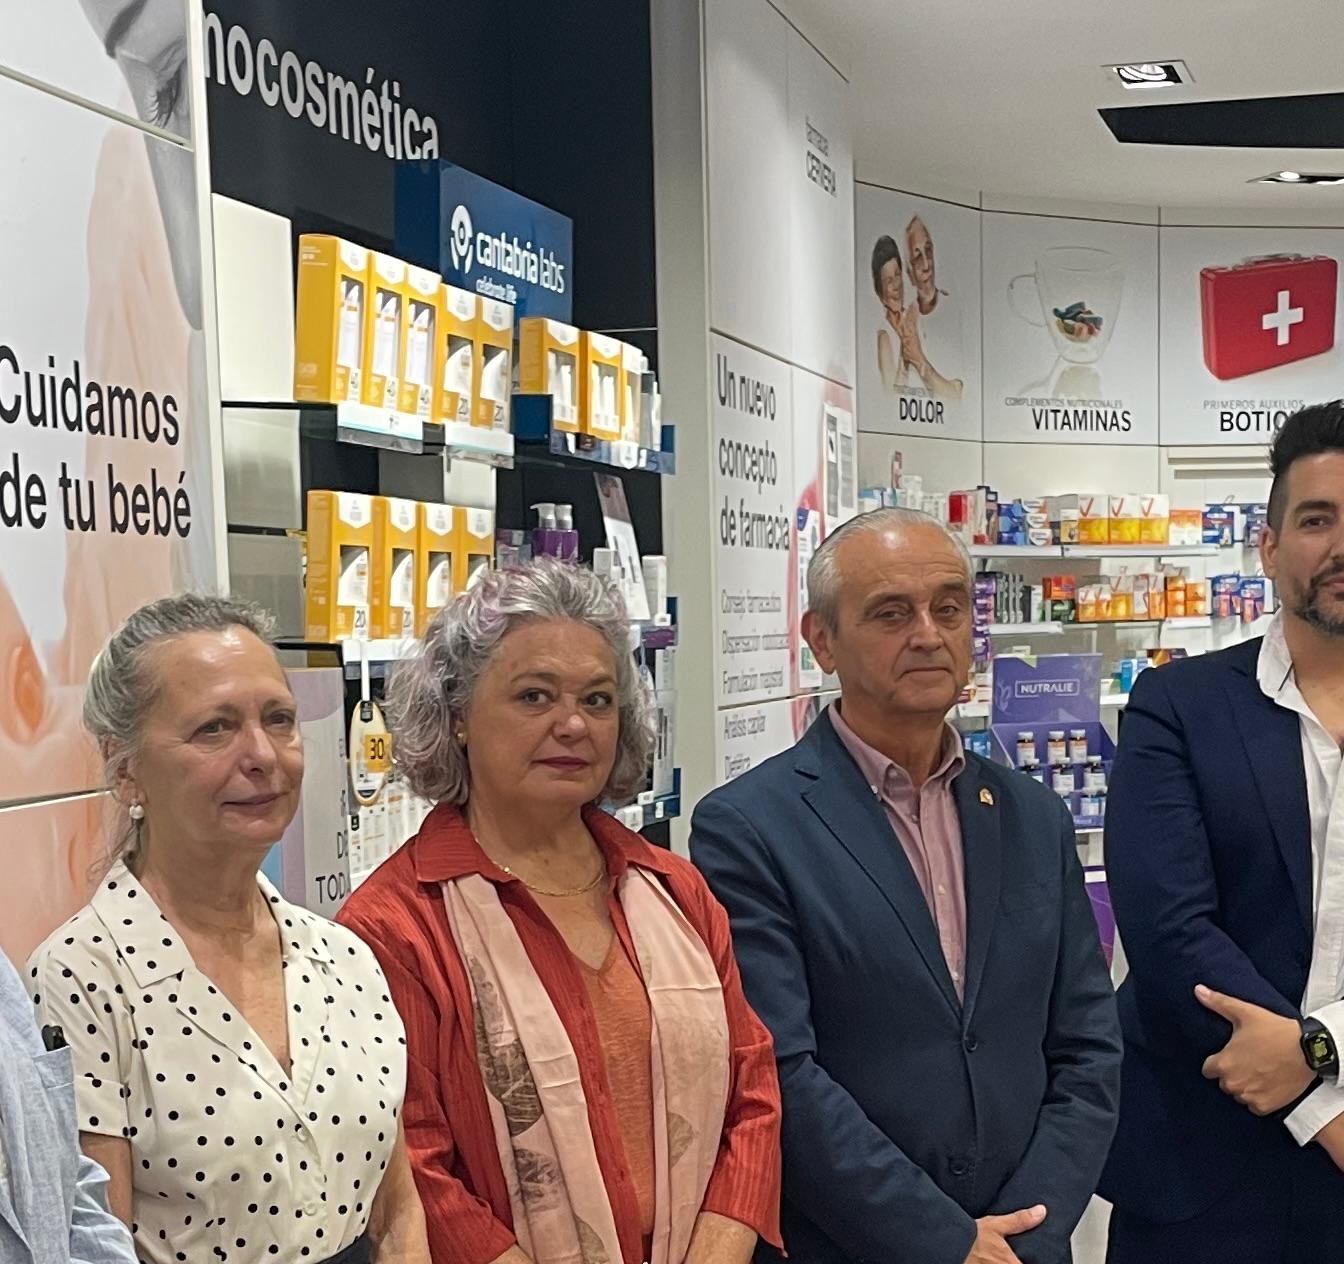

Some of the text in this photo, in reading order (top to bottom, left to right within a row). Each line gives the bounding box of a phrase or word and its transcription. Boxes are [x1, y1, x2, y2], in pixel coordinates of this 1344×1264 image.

[476, 231, 565, 294] cantabria labs
[717, 353, 777, 421] Un nuevo
[1203, 399, 1305, 410] PRIMEROS AUXILIOS
[899, 397, 944, 424] DOLOR
[1032, 407, 1132, 432] VITAMINAS
[719, 437, 778, 495] concepto
[59, 472, 95, 532] tu
[110, 471, 193, 538] bebé
[720, 495, 791, 551] de farmacia
[1020, 681, 1074, 695] NUTRALIE
[369, 737, 385, 760] 30
[315, 871, 347, 906] TOD
